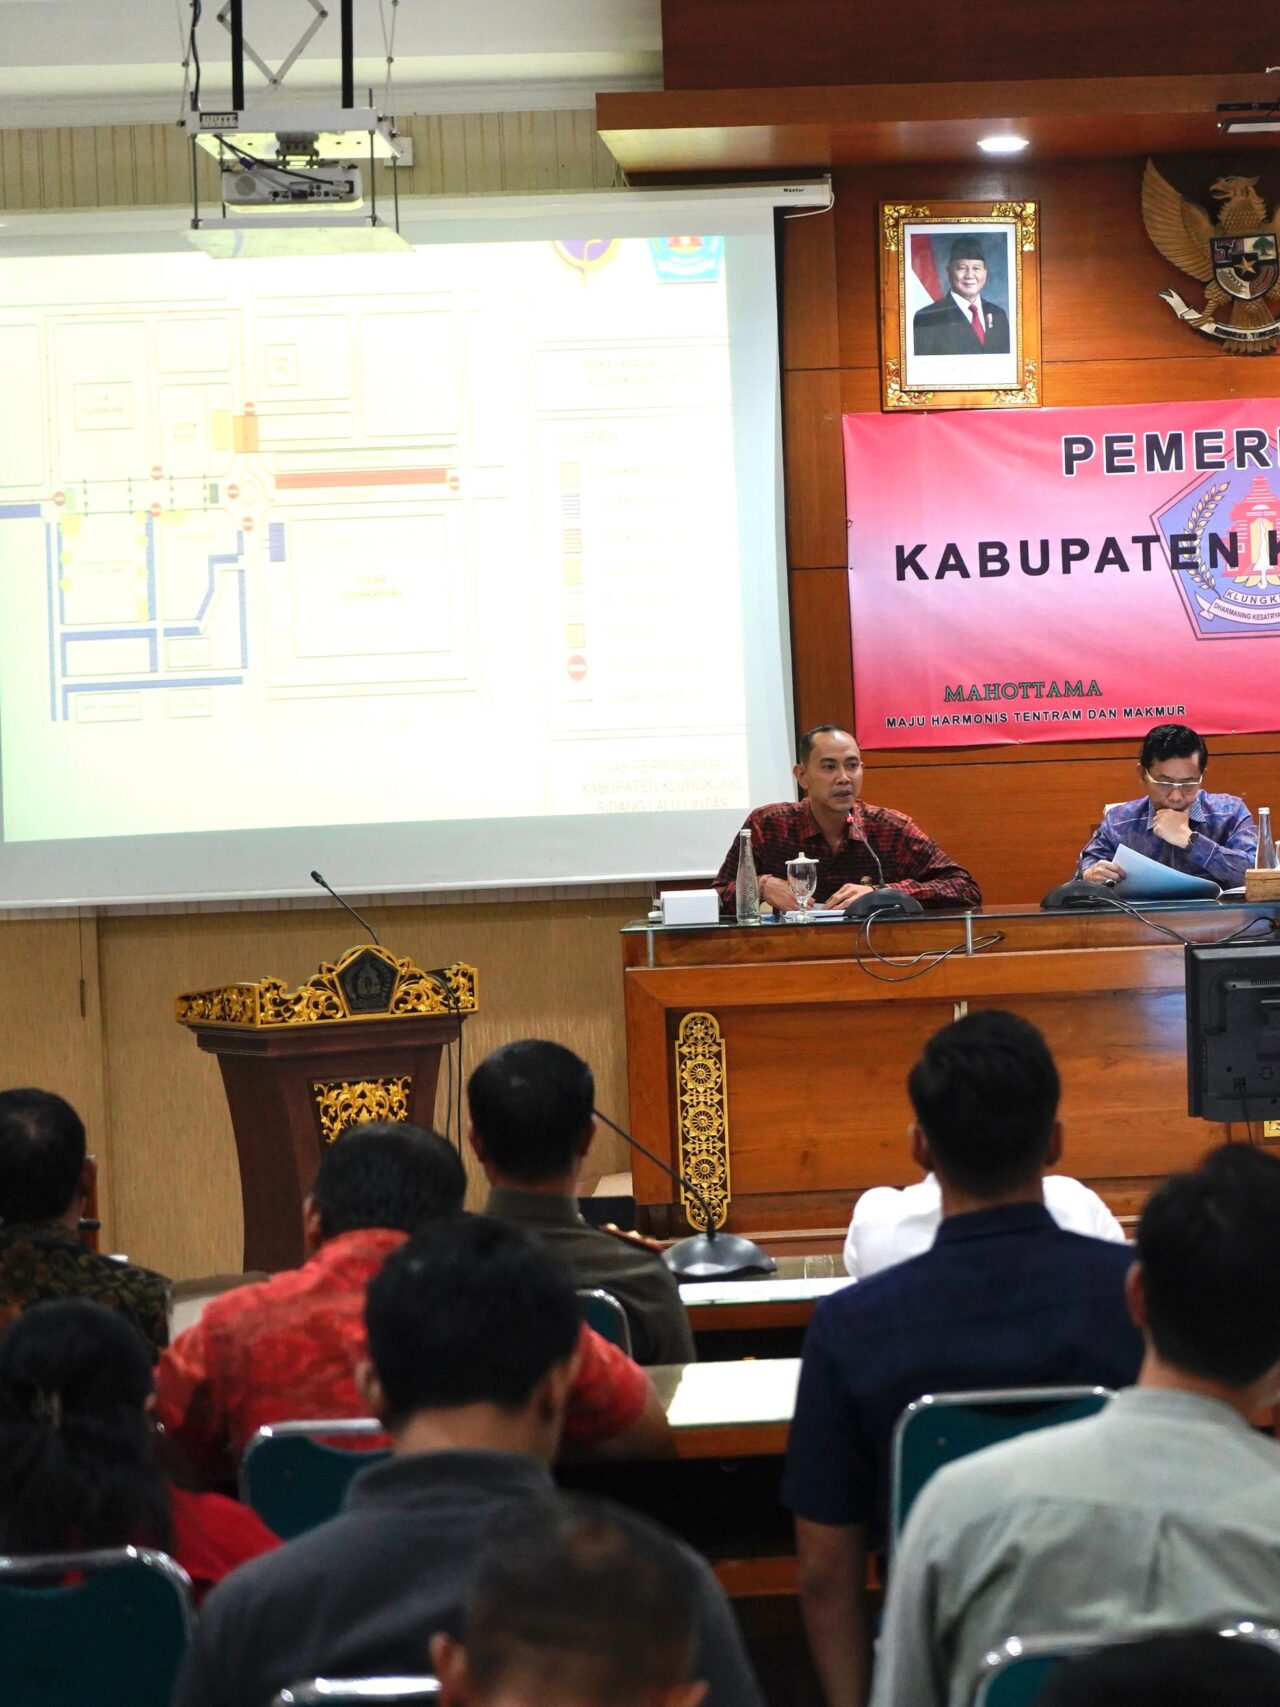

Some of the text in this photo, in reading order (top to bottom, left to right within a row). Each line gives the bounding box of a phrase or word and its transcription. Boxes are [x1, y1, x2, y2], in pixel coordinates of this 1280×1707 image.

[895, 533, 1239, 581] KABUPATEN
[1213, 602, 1251, 620] DHARMANING
[1251, 612, 1280, 621] KESATRYA
[944, 680, 1103, 702] MAHOTTAMA
[886, 705, 1187, 727] MAJU HARMONIS TENTRAM DAN MAKMUR
